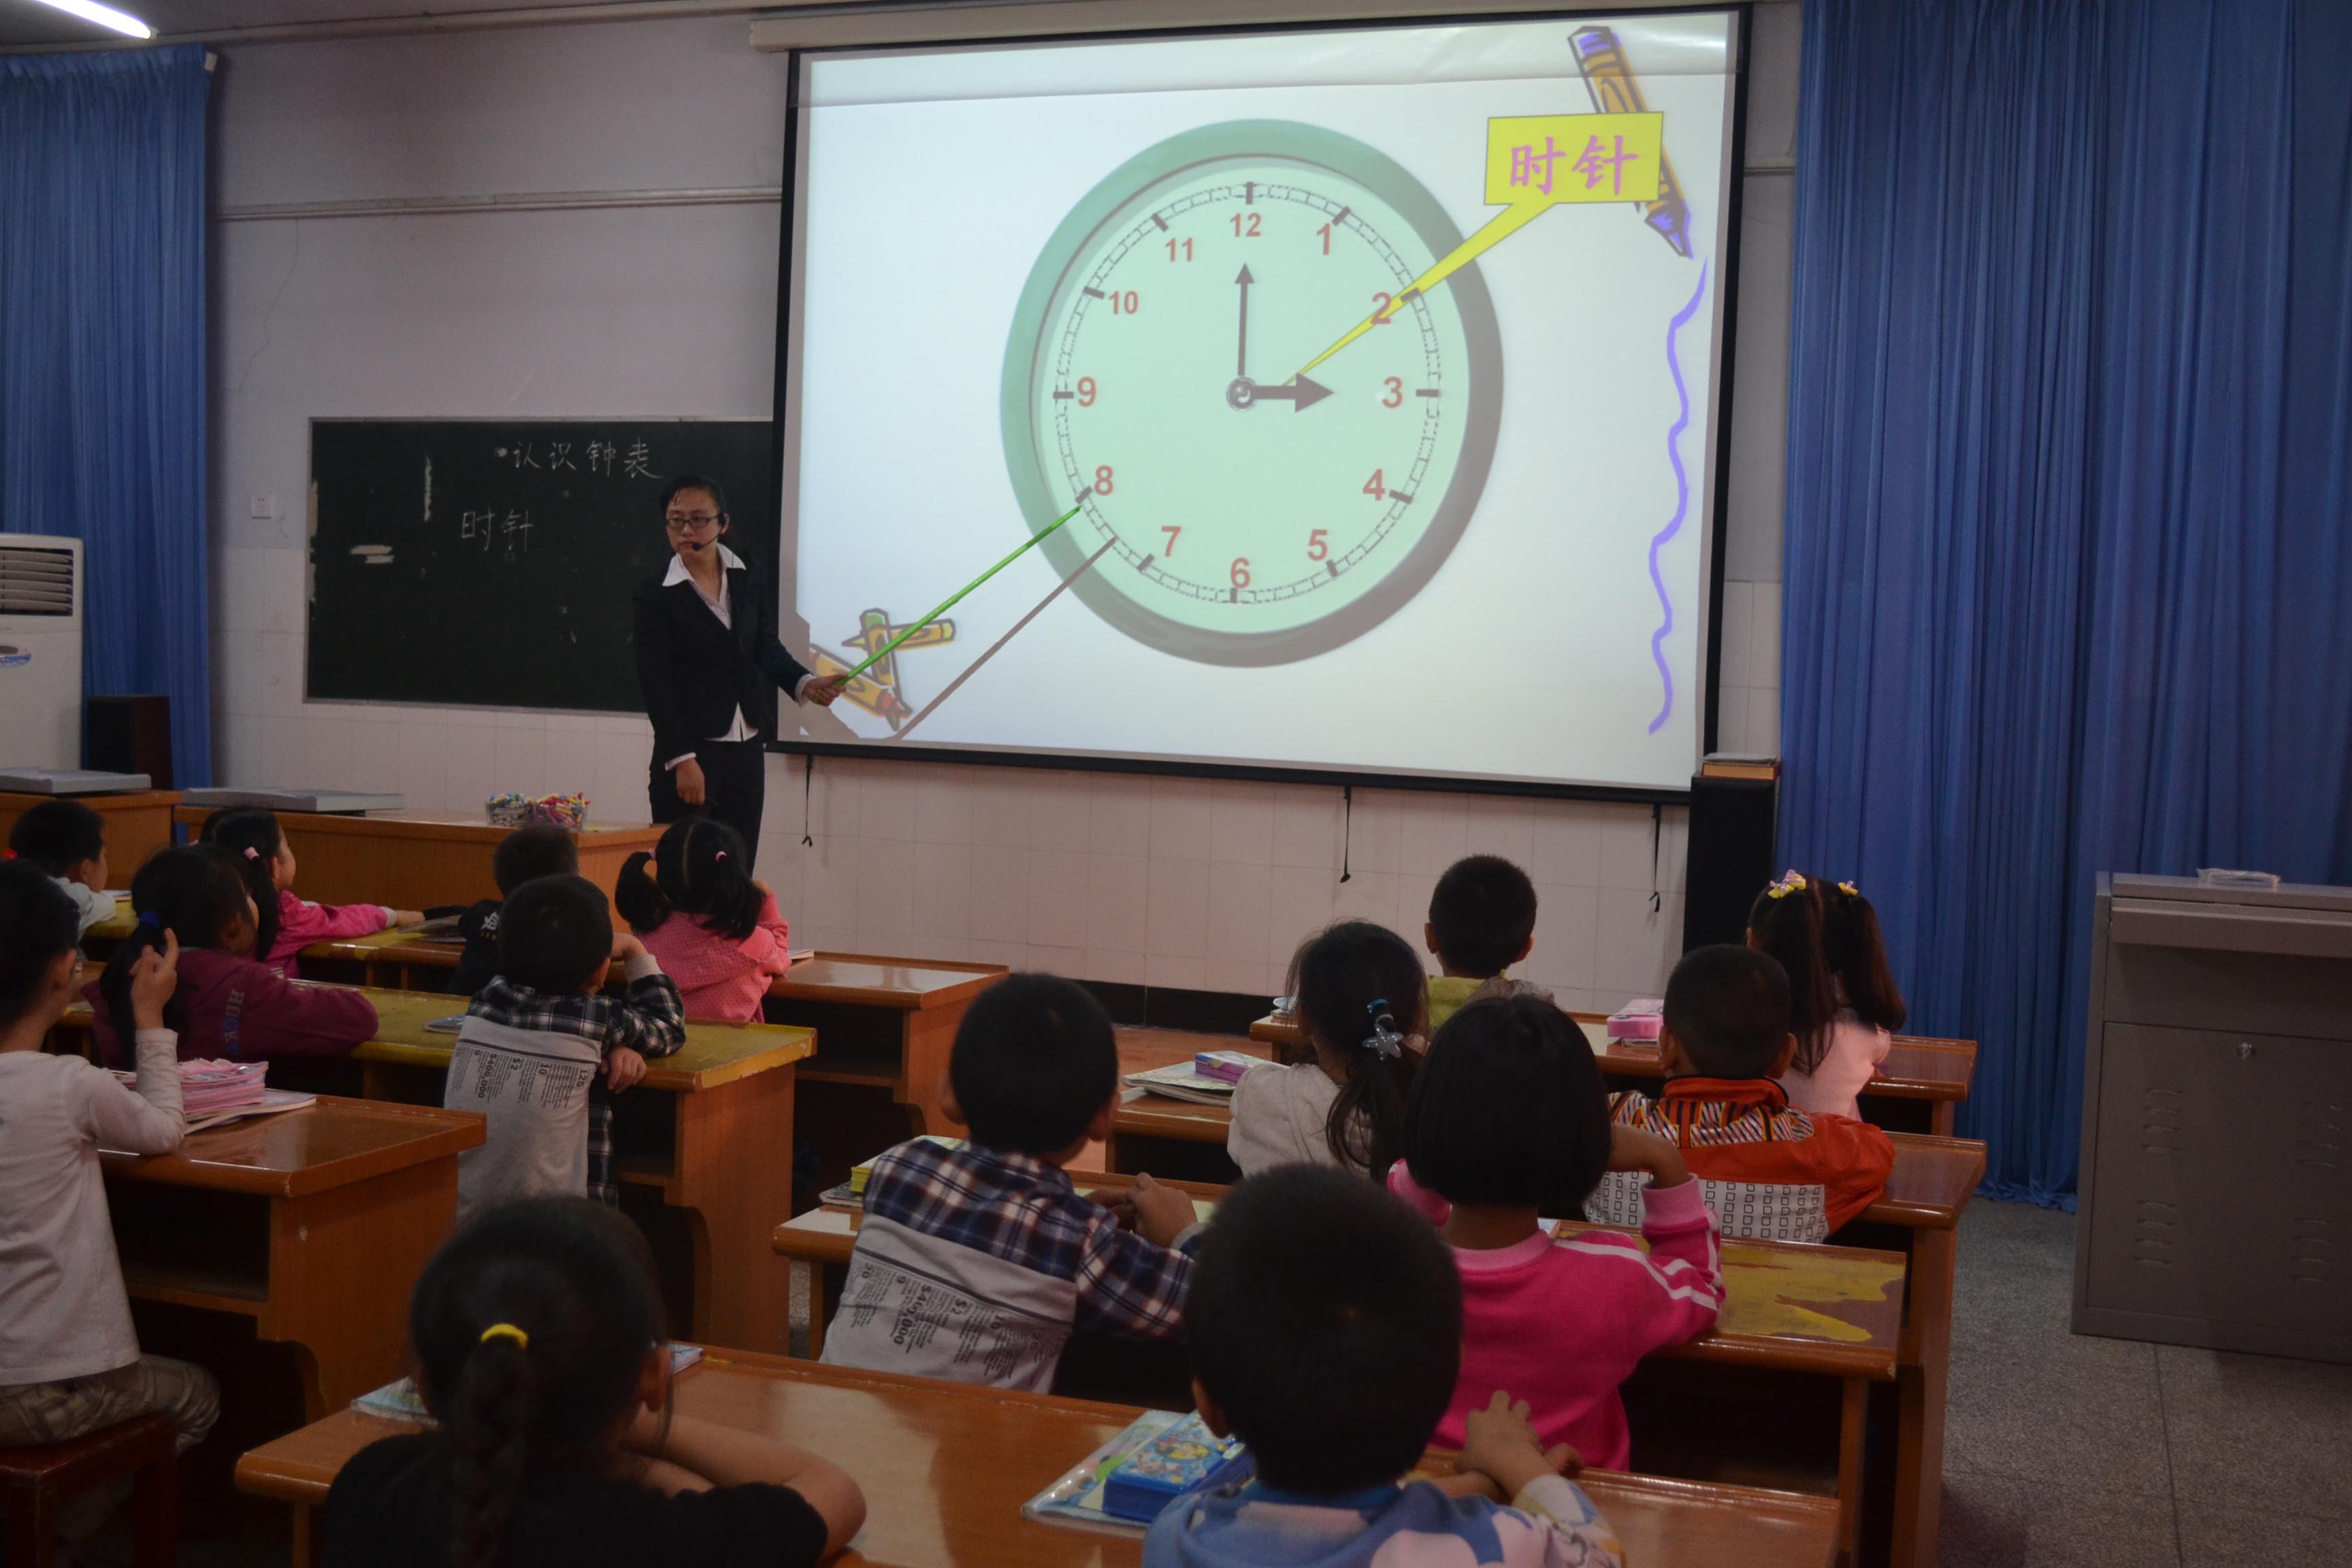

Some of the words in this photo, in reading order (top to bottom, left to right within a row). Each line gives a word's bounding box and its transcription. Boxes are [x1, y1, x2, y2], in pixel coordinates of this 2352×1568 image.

[1510, 135, 1639, 196] 时针
[1230, 212, 1261, 237] 12
[1316, 223, 1331, 255] 1
[1165, 238, 1193, 261] 11
[1108, 291, 1138, 314] 10
[1370, 292, 1392, 324] 2
[1077, 377, 1096, 407] 9
[1382, 377, 1402, 408] 3
[512, 437, 664, 478] 认识钟表
[1094, 466, 1113, 496] 8
[1362, 469, 1385, 500] 4
[460, 506, 535, 553] 时针
[1161, 526, 1181, 557] 7
[1307, 529, 1328, 561] 5
[1230, 558, 1251, 589] 6
